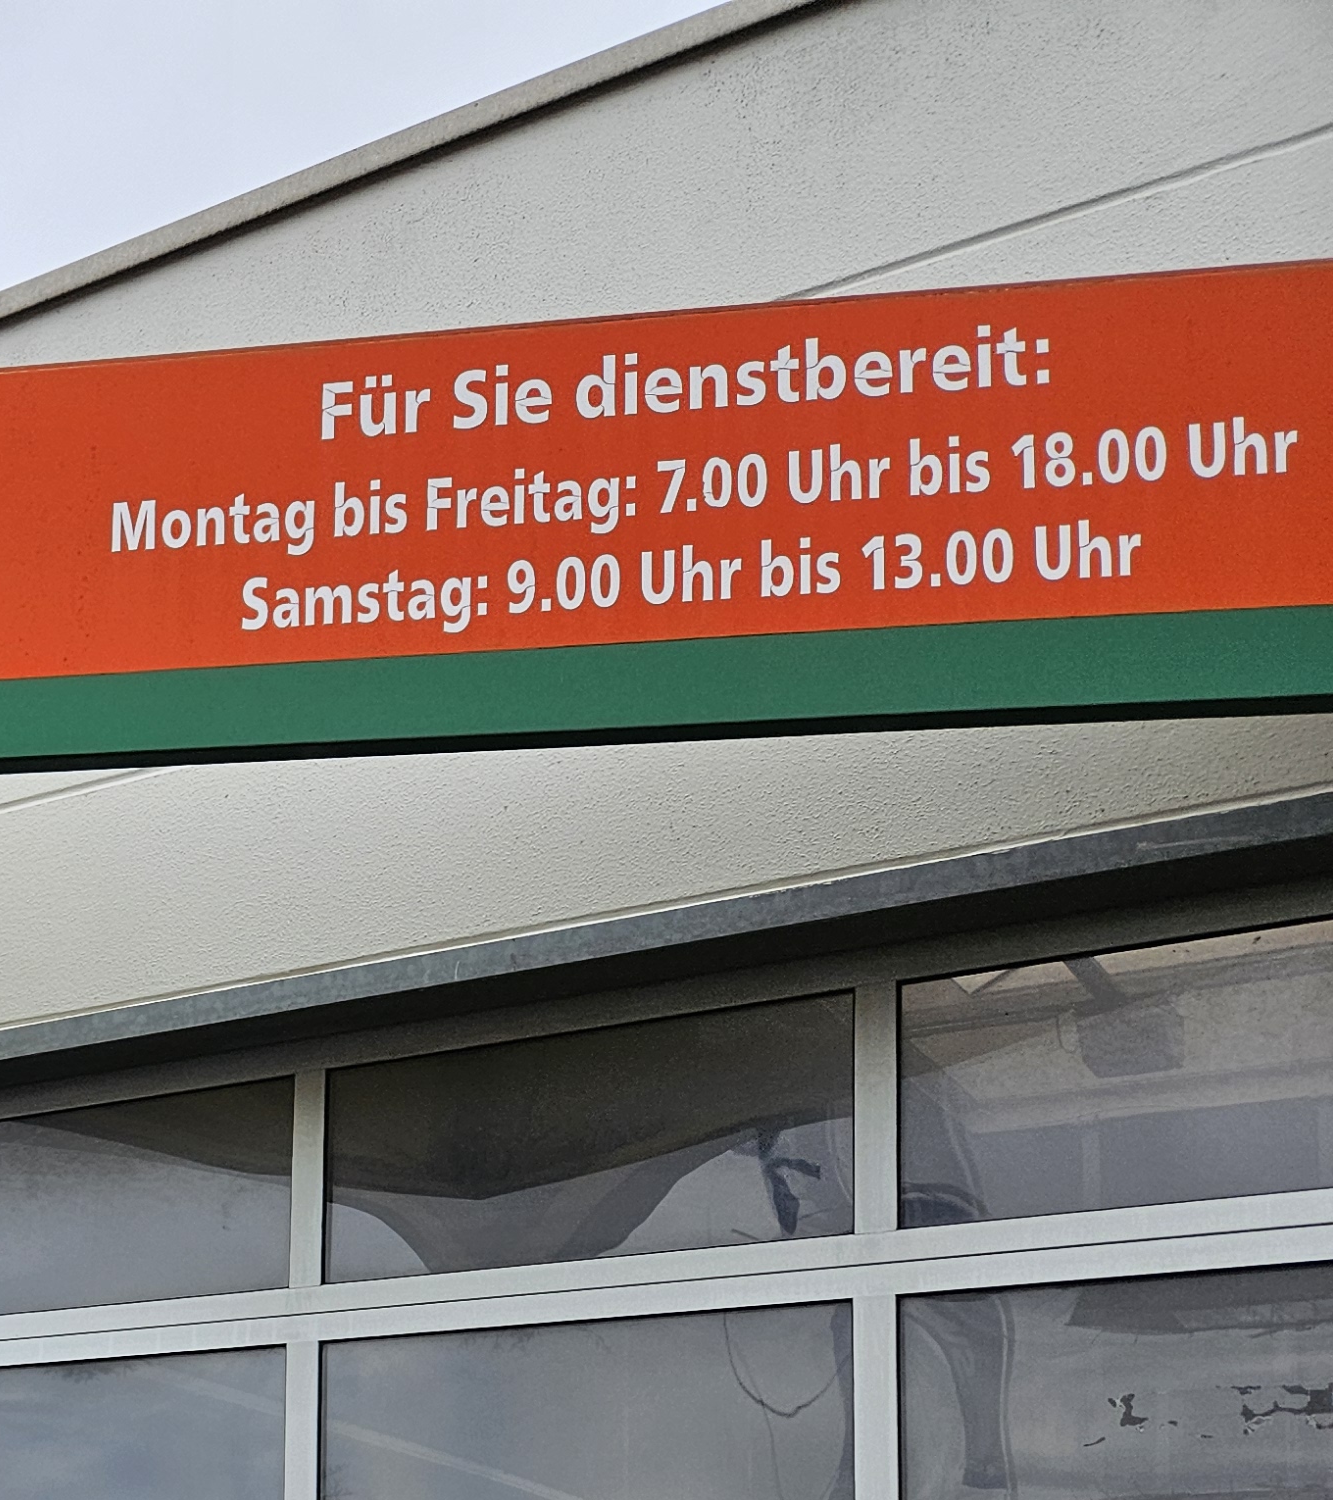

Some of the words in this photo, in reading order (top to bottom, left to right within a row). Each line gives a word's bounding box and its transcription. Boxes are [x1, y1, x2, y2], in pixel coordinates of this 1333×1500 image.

[321, 374, 431, 440] Für
[453, 364, 553, 430] Sie
[575, 324, 1051, 420] dienstbereit:
[111, 493, 315, 556] Montag
[333, 479, 408, 538] bis
[426, 468, 637, 535] Freitag:
[657, 453, 768, 514] 7.00
[788, 443, 891, 504] Uhr
[909, 435, 991, 496] bis
[1011, 426, 1167, 489] 18.00
[1188, 416, 1299, 478] Uhr
[241, 569, 488, 633] Samstag:
[507, 553, 621, 614] 9.00
[641, 544, 742, 605] Uhr
[760, 536, 841, 598] bis
[861, 528, 1014, 590] 13.00
[1034, 519, 1143, 581] Uhr
